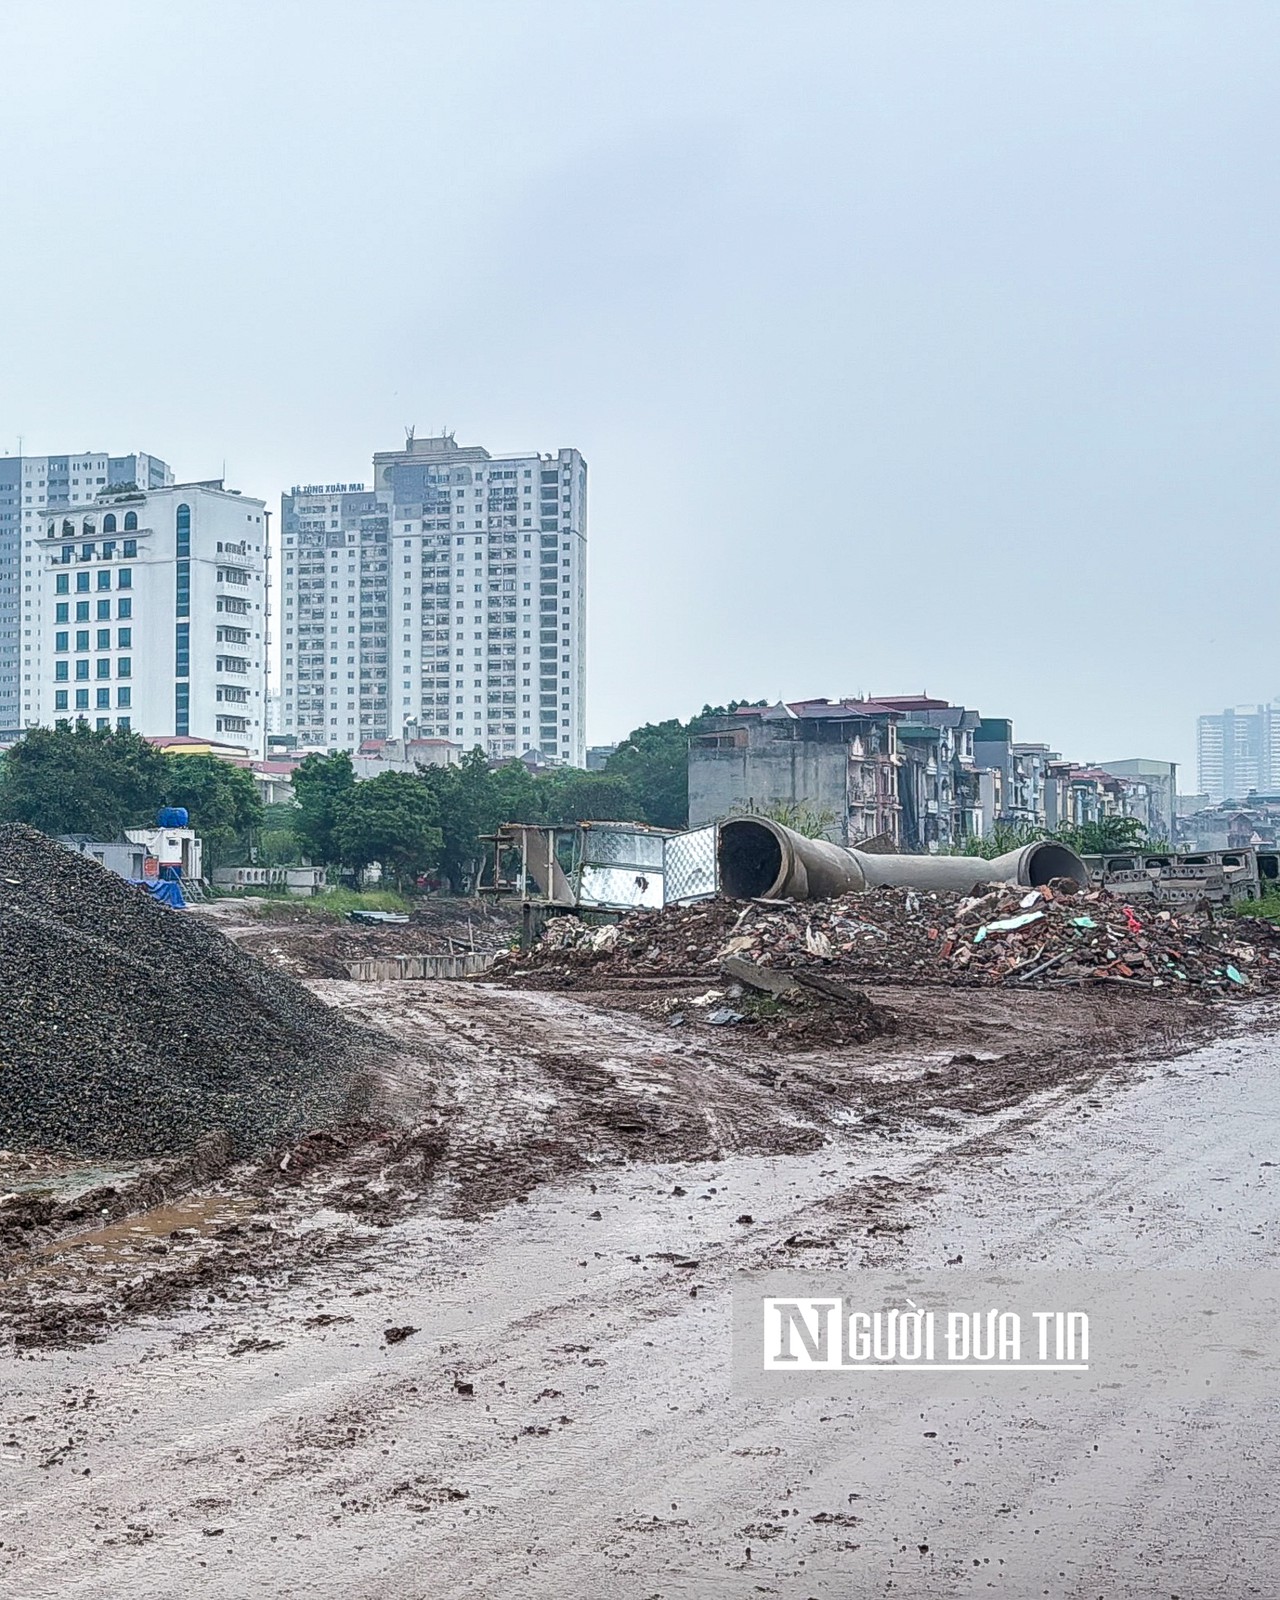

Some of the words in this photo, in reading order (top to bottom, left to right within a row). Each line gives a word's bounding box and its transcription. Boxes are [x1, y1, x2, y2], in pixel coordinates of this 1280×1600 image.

[303, 484, 323, 494] TÔNG
[325, 483, 347, 493] XUÂN
[348, 483, 364, 492] MAI
